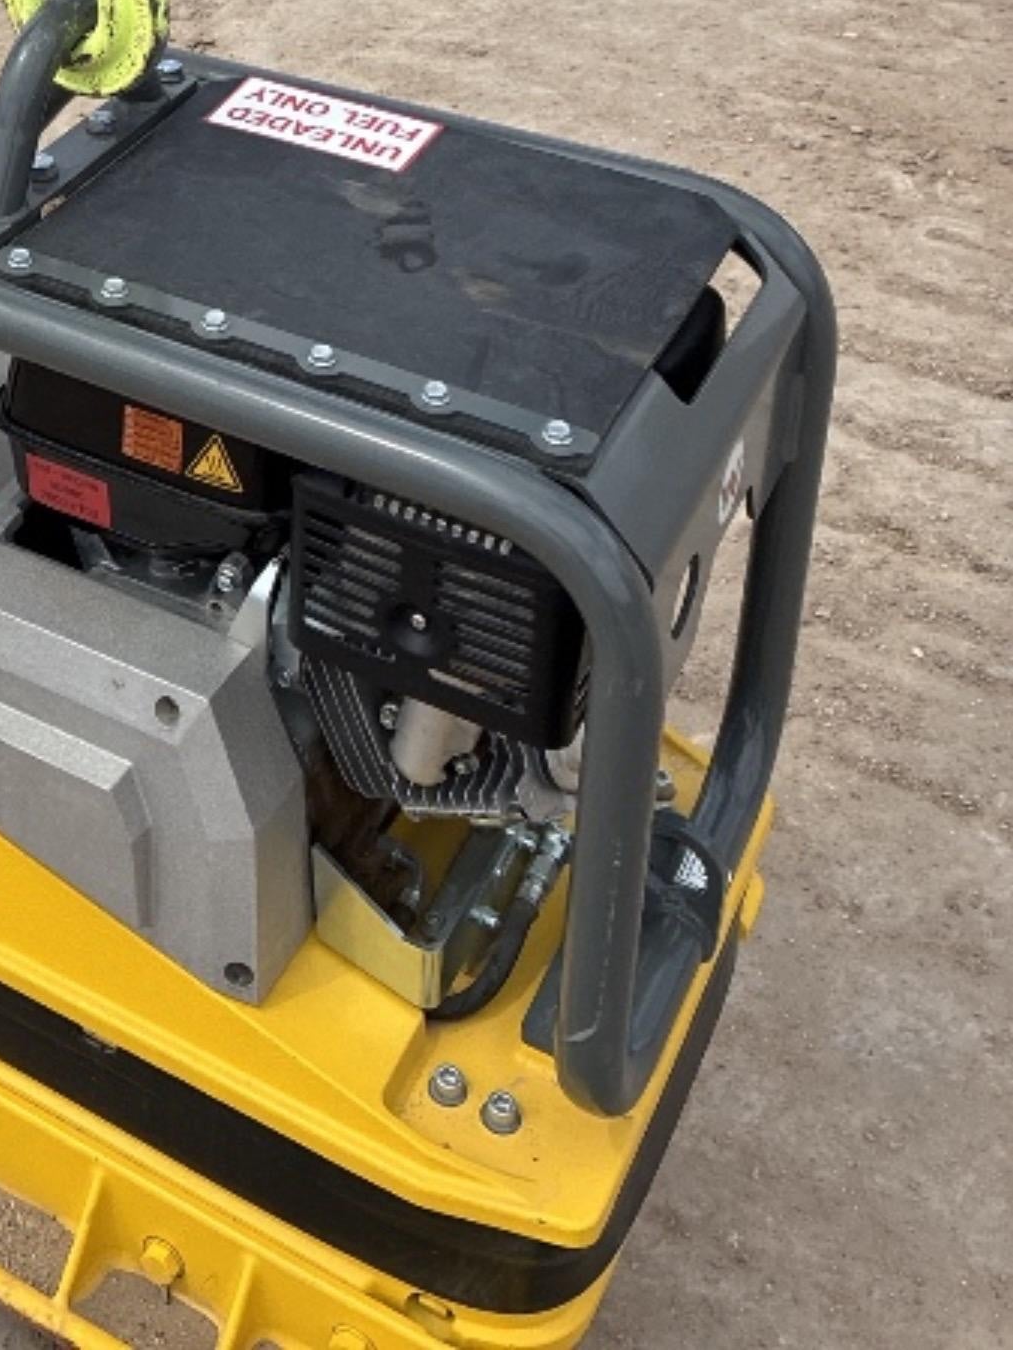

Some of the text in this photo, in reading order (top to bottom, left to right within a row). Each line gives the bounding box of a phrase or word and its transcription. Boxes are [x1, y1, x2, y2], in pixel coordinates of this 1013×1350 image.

[227, 107, 402, 161] UNLEADED
[244, 87, 423, 142] FUEL ONLY
